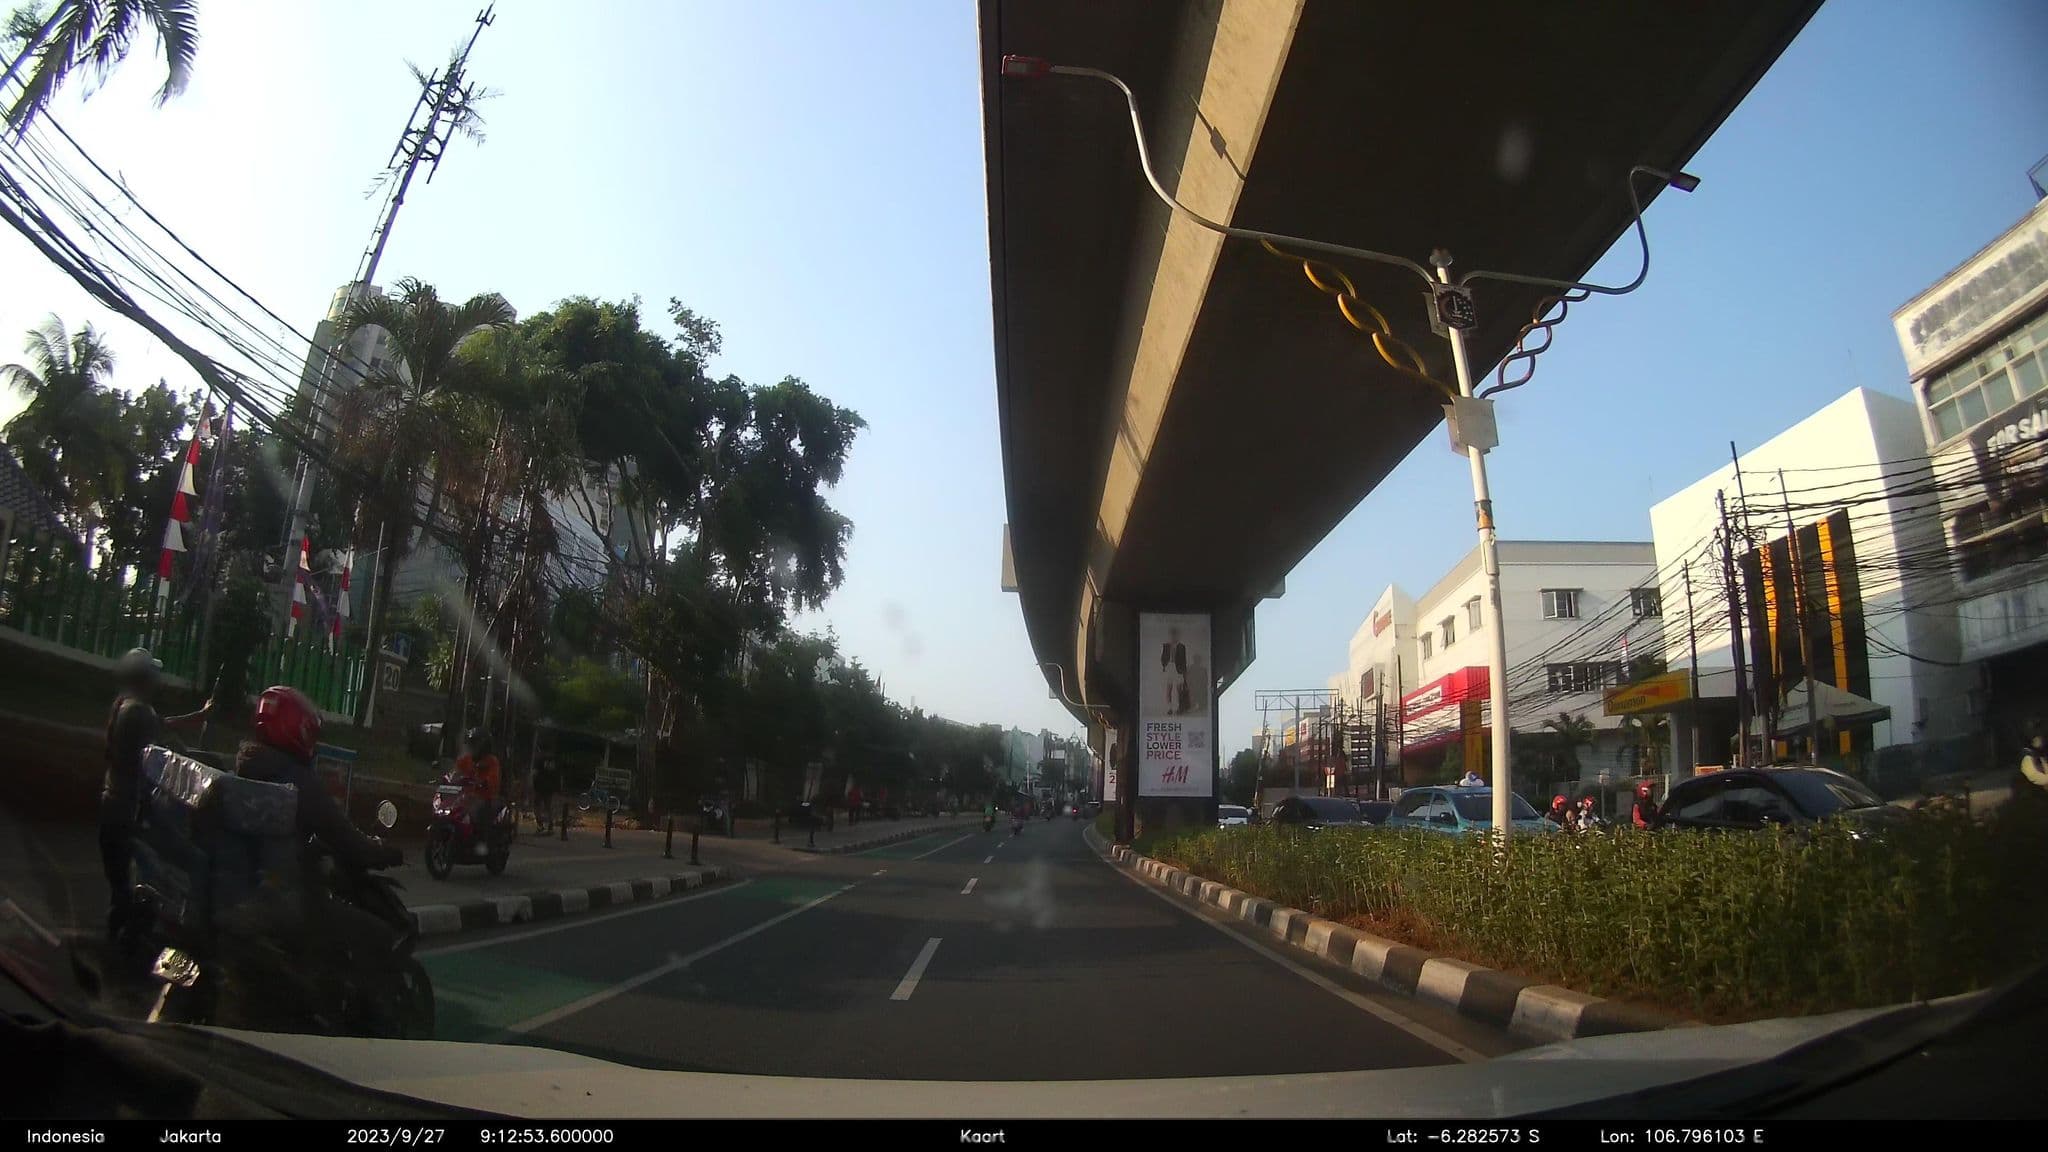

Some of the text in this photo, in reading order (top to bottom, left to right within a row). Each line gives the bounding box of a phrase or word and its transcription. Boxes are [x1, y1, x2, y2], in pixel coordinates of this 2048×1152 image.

[1146, 723, 1182, 732] FRESH
[1146, 732, 1182, 741] STYLE
[1146, 742, 1182, 750] LOWER
[1146, 751, 1182, 760] PRICE
